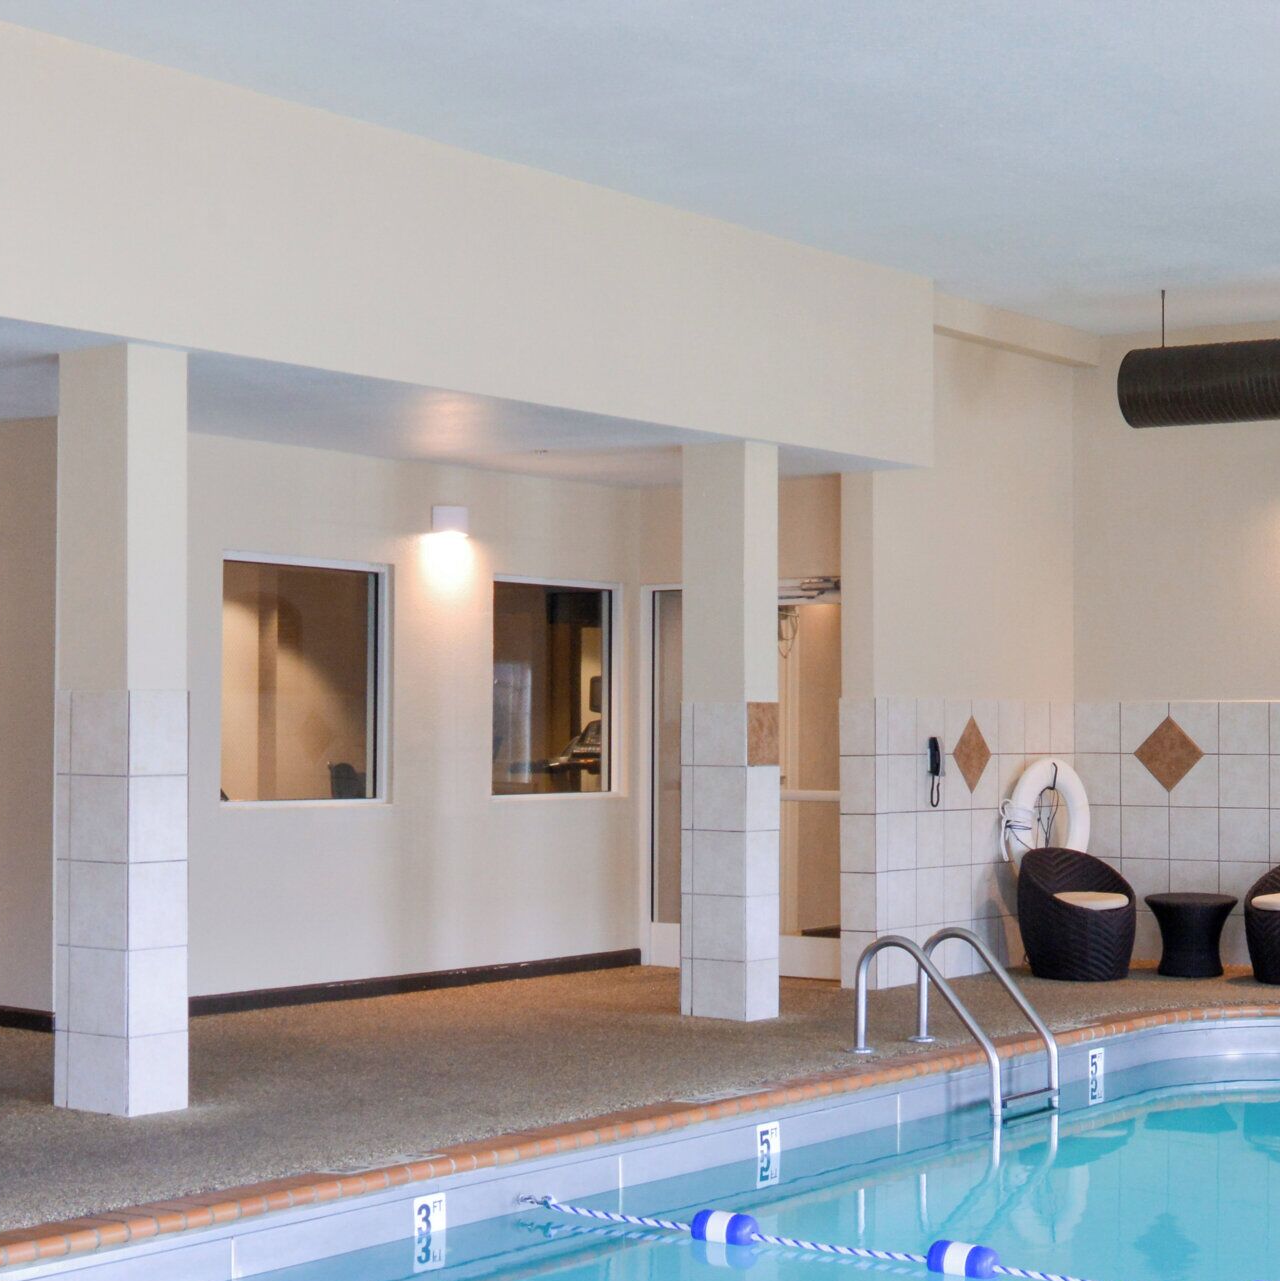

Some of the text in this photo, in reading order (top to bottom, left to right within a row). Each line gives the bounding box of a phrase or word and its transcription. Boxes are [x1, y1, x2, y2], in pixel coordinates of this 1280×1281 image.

[1090, 1054, 1097, 1076] 5
[760, 1130, 770, 1156] 5
[417, 1200, 443, 1236] 3 FT
